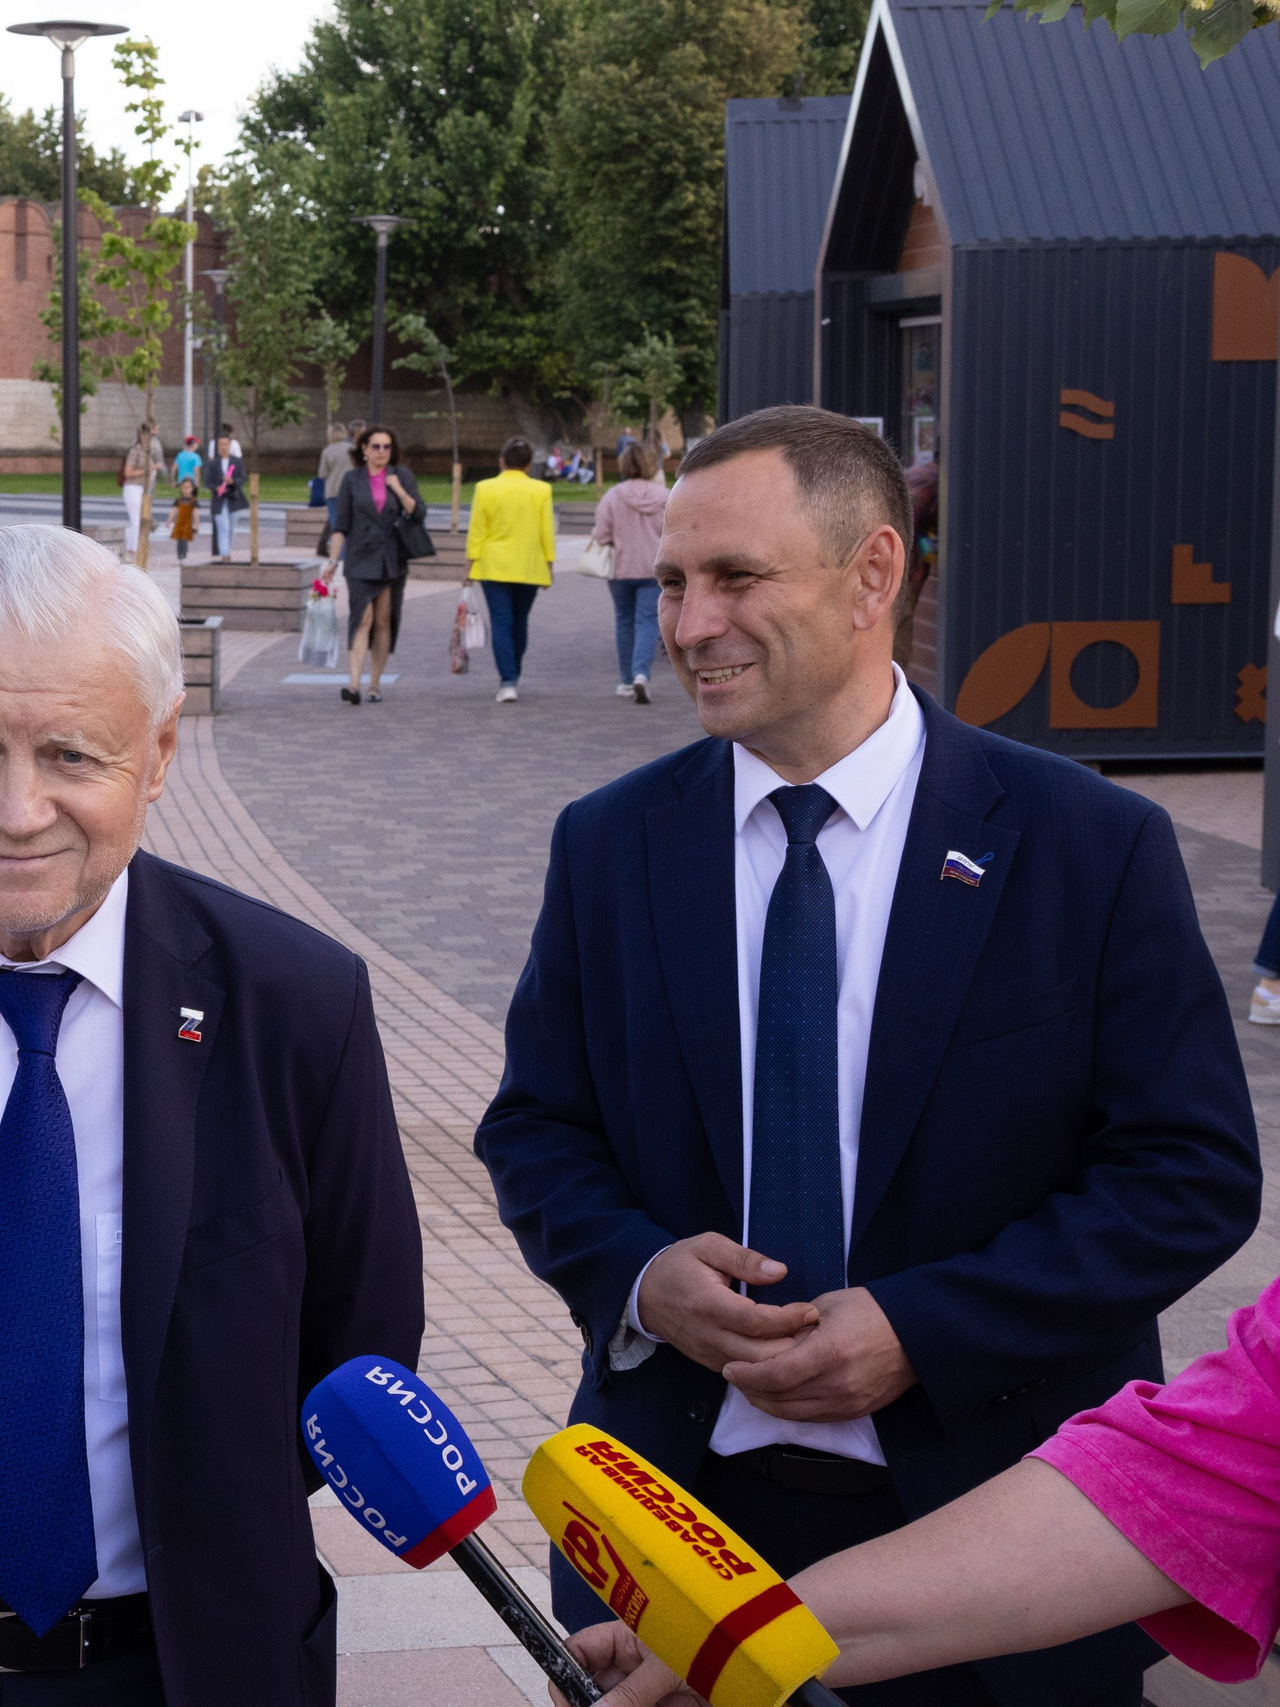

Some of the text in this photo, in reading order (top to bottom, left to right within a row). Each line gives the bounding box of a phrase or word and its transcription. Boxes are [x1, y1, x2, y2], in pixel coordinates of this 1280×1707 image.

[306, 1413, 408, 1548] РОССИЯ
[365, 1366, 478, 1496] РОССИЯ
[574, 1445, 734, 1581] СПРАВЕДЛИВАЯ
[587, 1440, 758, 1576] РОССИЯ
